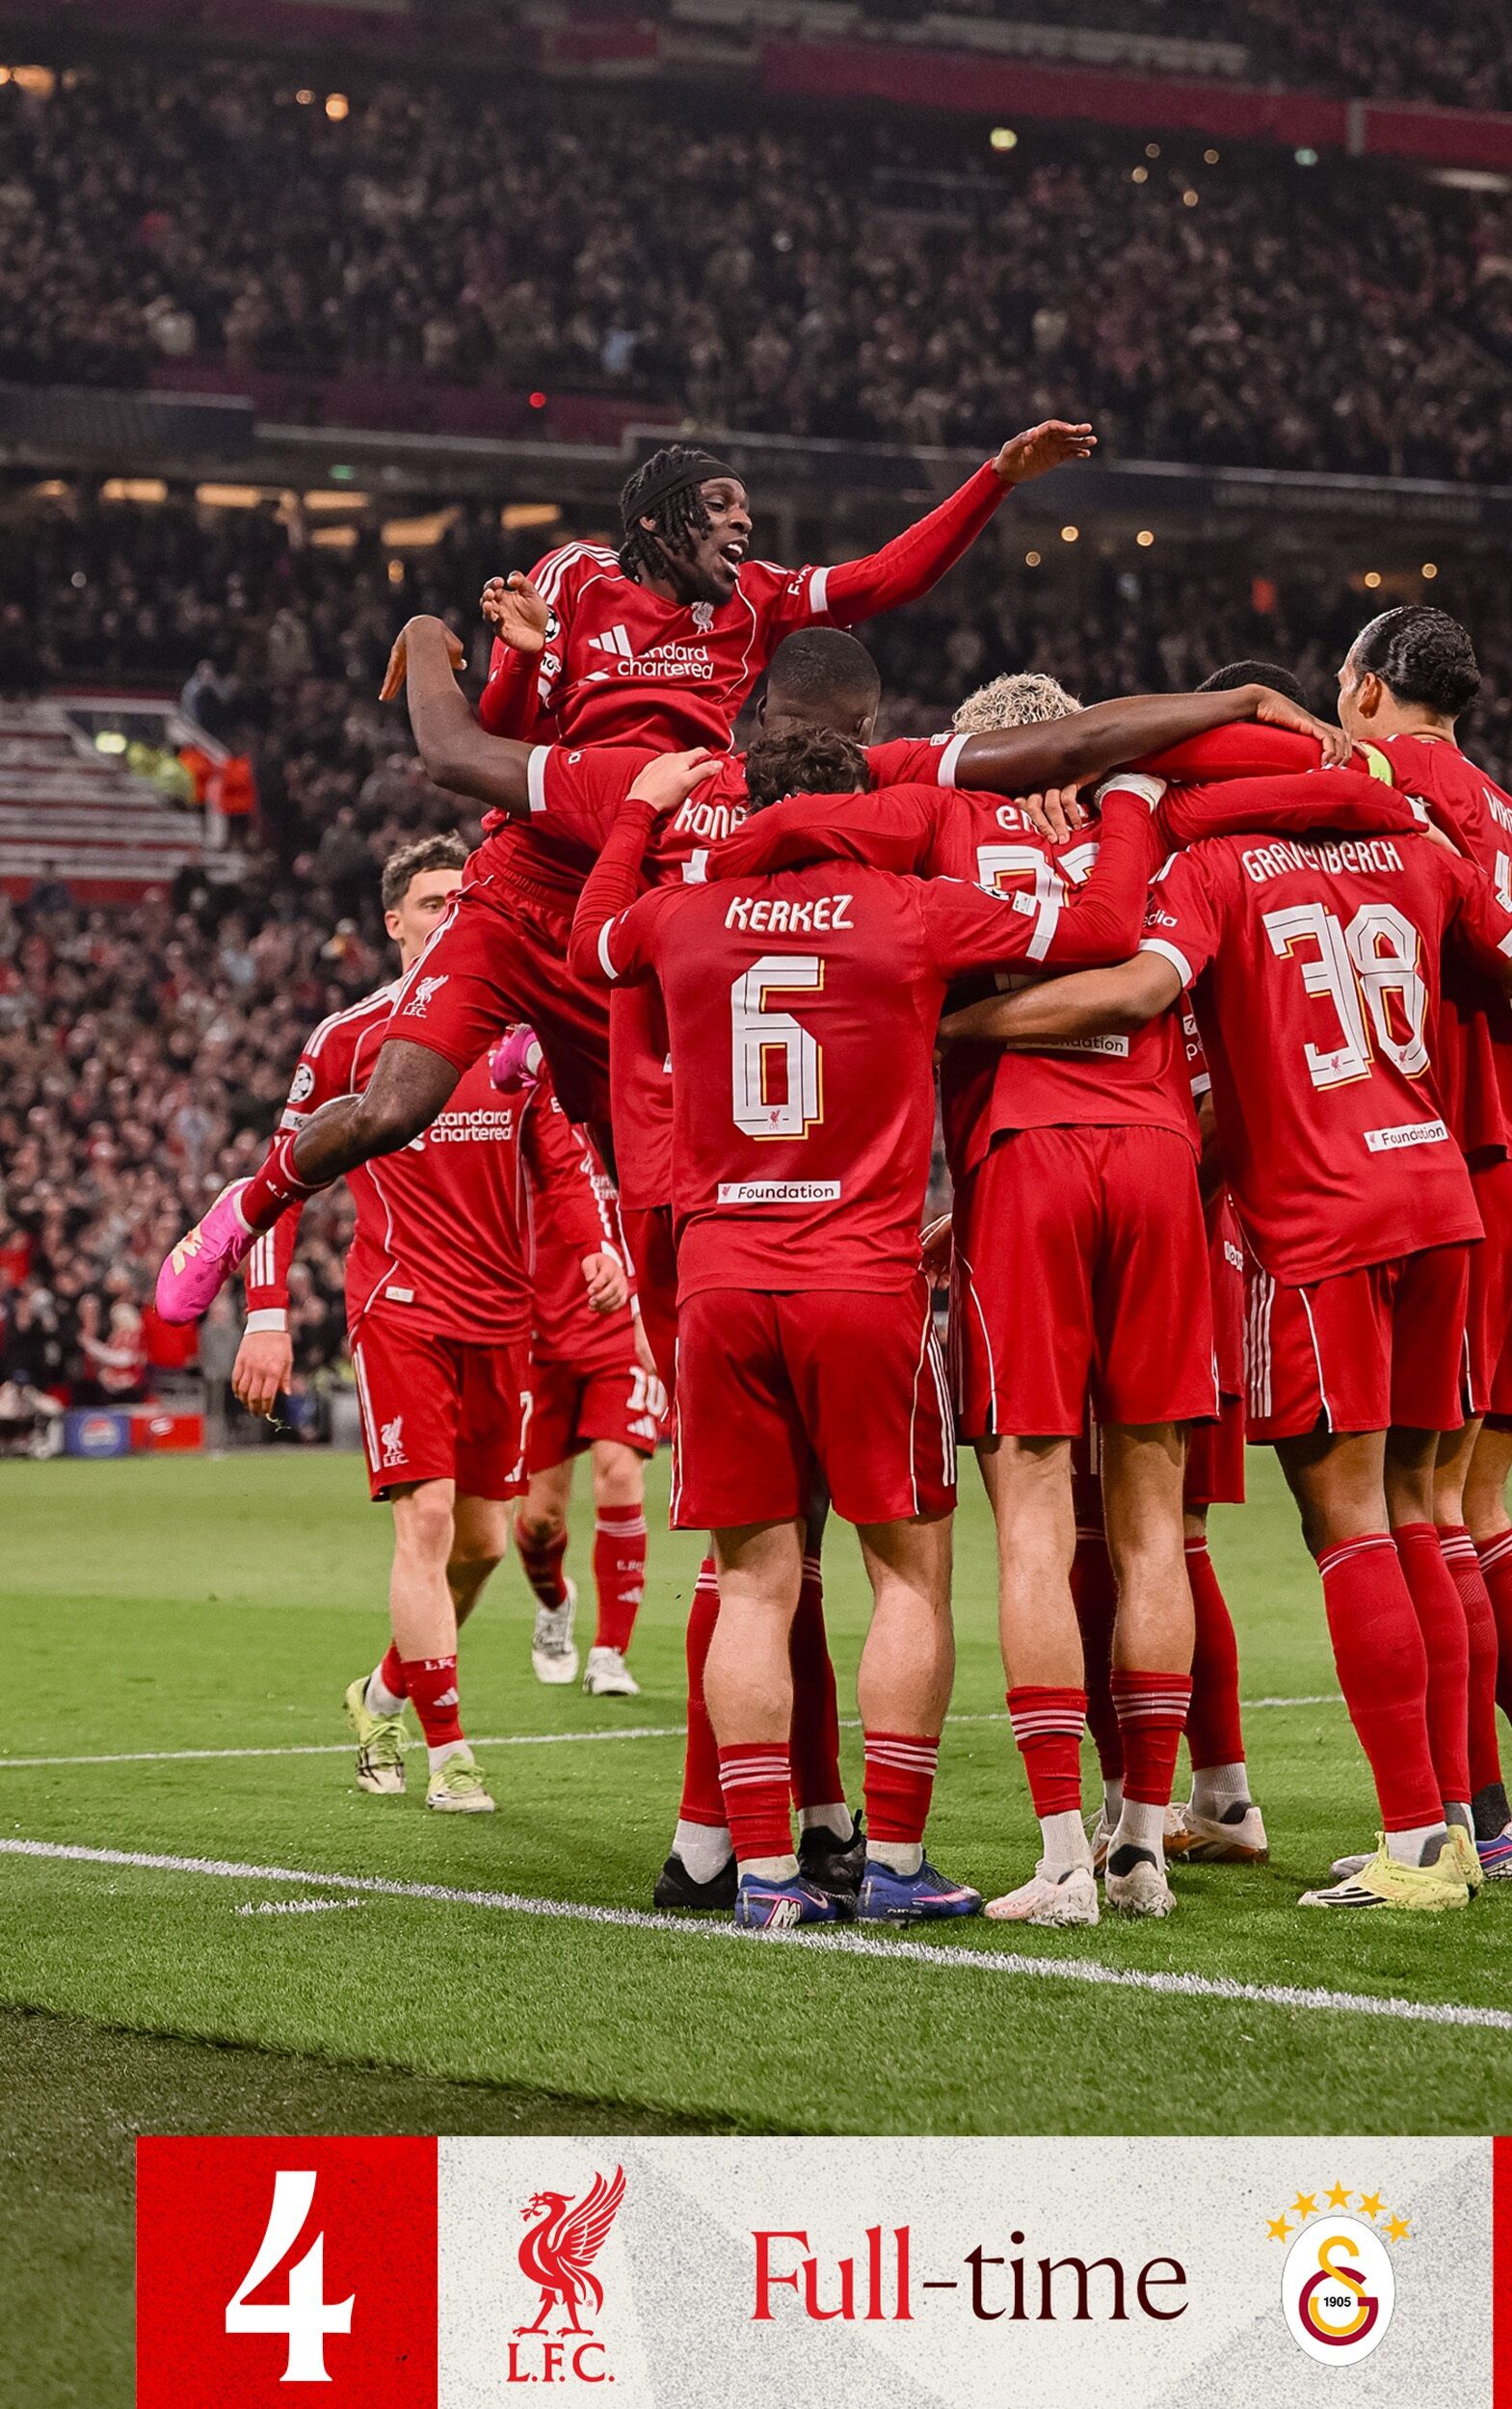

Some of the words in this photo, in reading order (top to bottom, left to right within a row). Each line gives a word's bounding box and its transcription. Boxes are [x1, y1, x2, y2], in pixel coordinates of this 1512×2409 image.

[618, 659, 714, 679] chartered
[725, 894, 855, 932] KERKEZ
[1262, 902, 1430, 1091] 38
[731, 955, 824, 1142] 6
[430, 1125, 514, 1143] chartered
[1382, 1126, 1444, 1145] Foundation
[737, 1184, 835, 1199] Foundation
